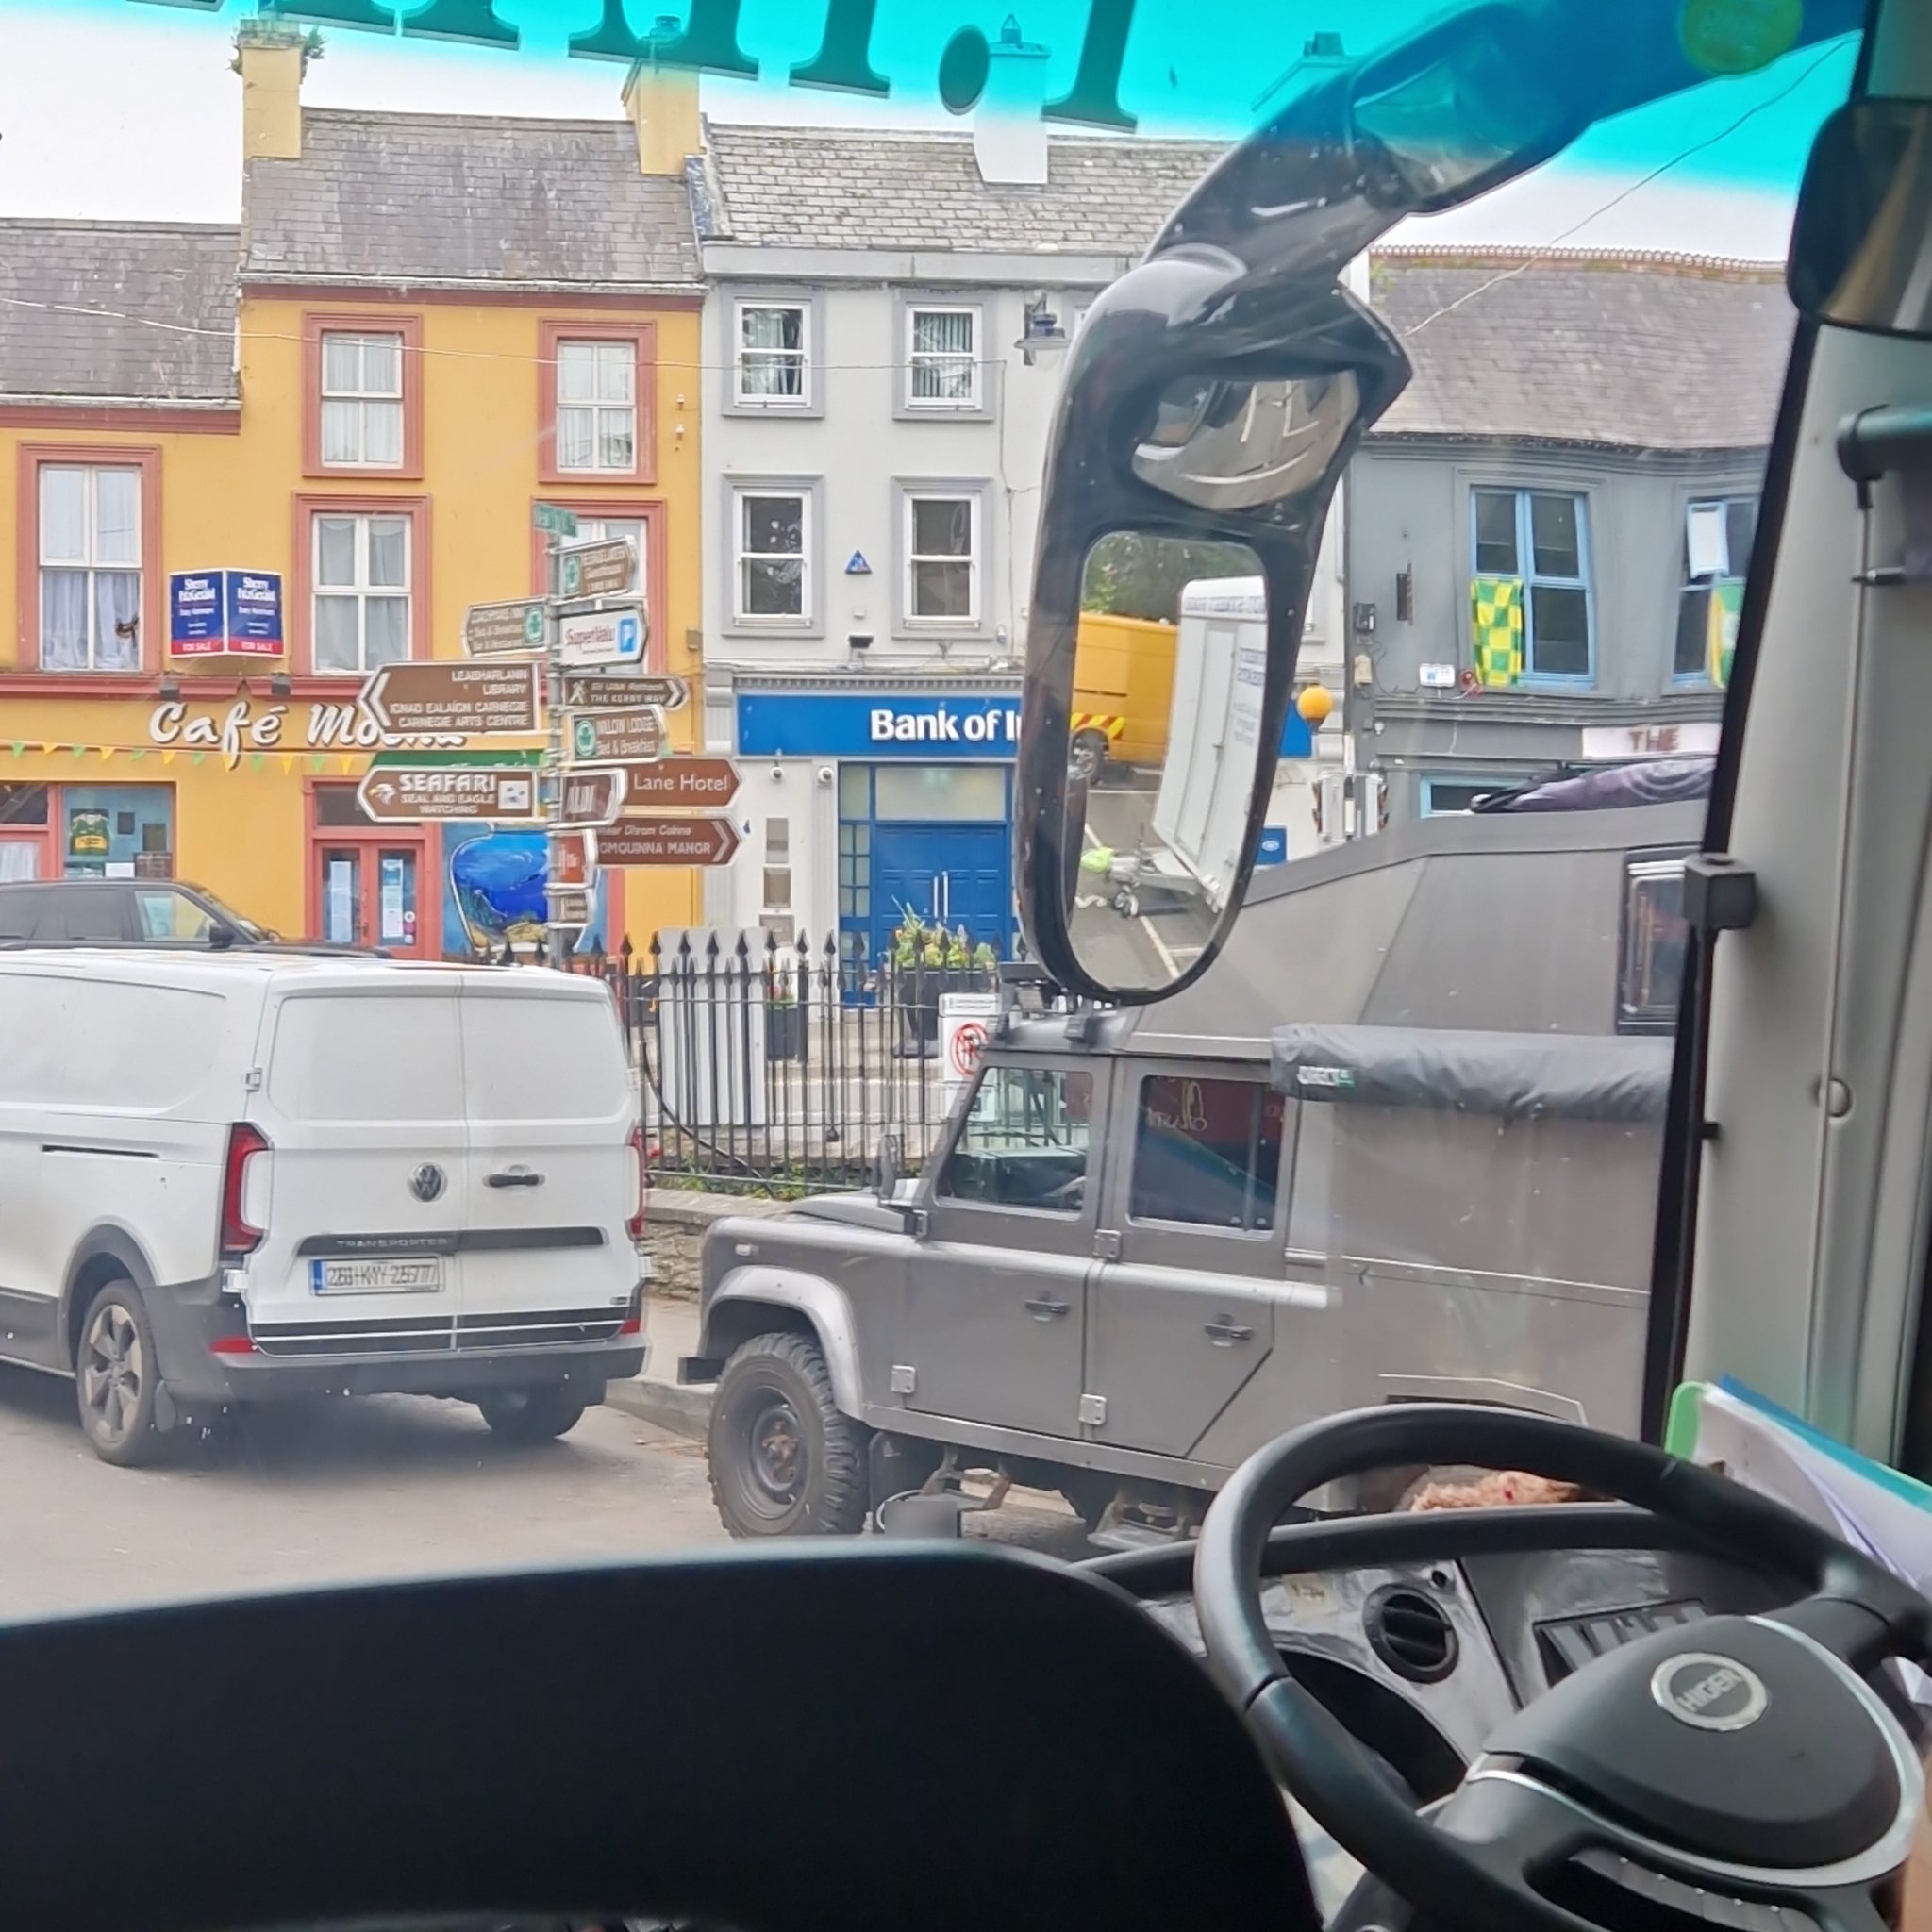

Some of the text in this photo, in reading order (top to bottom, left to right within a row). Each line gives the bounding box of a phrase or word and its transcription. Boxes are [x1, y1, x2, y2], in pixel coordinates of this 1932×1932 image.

[482, 684, 526, 696] LIBRARY
[590, 694, 609, 703] THE
[643, 694, 667, 703] WAY
[475, 701, 528, 713] CARNEGIE
[398, 715, 528, 728] CARNEGIE ARTS CENTRE
[871, 708, 959, 741] Bank
[963, 709, 1002, 741] of
[149, 701, 288, 769] Café
[1627, 726, 1681, 753] THE
[399, 774, 497, 792] SEAFARI
[633, 773, 728, 791] Lane Hotel
[400, 793, 496, 804] SEAL AND EAGLE
[419, 805, 478, 814] WATCHING
[599, 841, 711, 855] OMQUINNA MANOR
[336, 1237, 448, 1248] TRANSPORTER
[1674, 1668, 1743, 1713] HIGER
